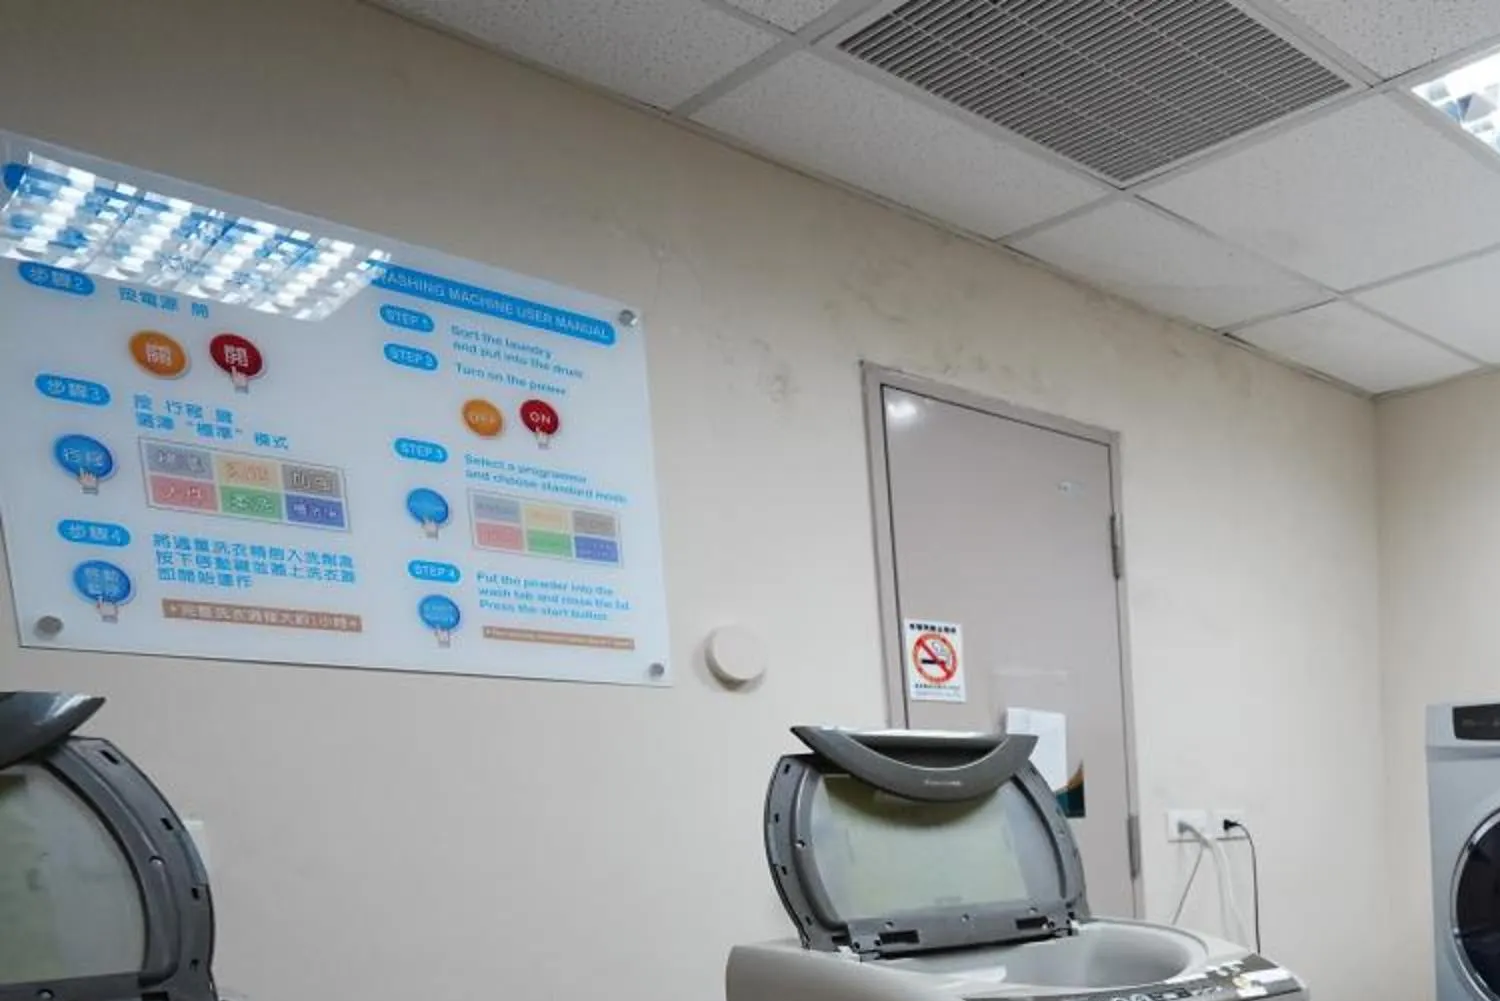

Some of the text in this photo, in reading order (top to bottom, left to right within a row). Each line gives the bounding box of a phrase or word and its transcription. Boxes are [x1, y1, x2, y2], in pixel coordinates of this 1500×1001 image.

[380, 269, 609, 338] ASHING MACHINE USER MANUAL
[386, 309, 418, 327] STEP
[451, 325, 480, 341] Sort
[483, 332, 502, 345] the
[391, 348, 421, 365] STEP
[456, 362, 485, 378] Turn
[506, 374, 526, 387] the
[529, 410, 551, 424] ON
[402, 442, 432, 457] STEP
[415, 564, 445, 577] STEP
[476, 571, 498, 584] Put
